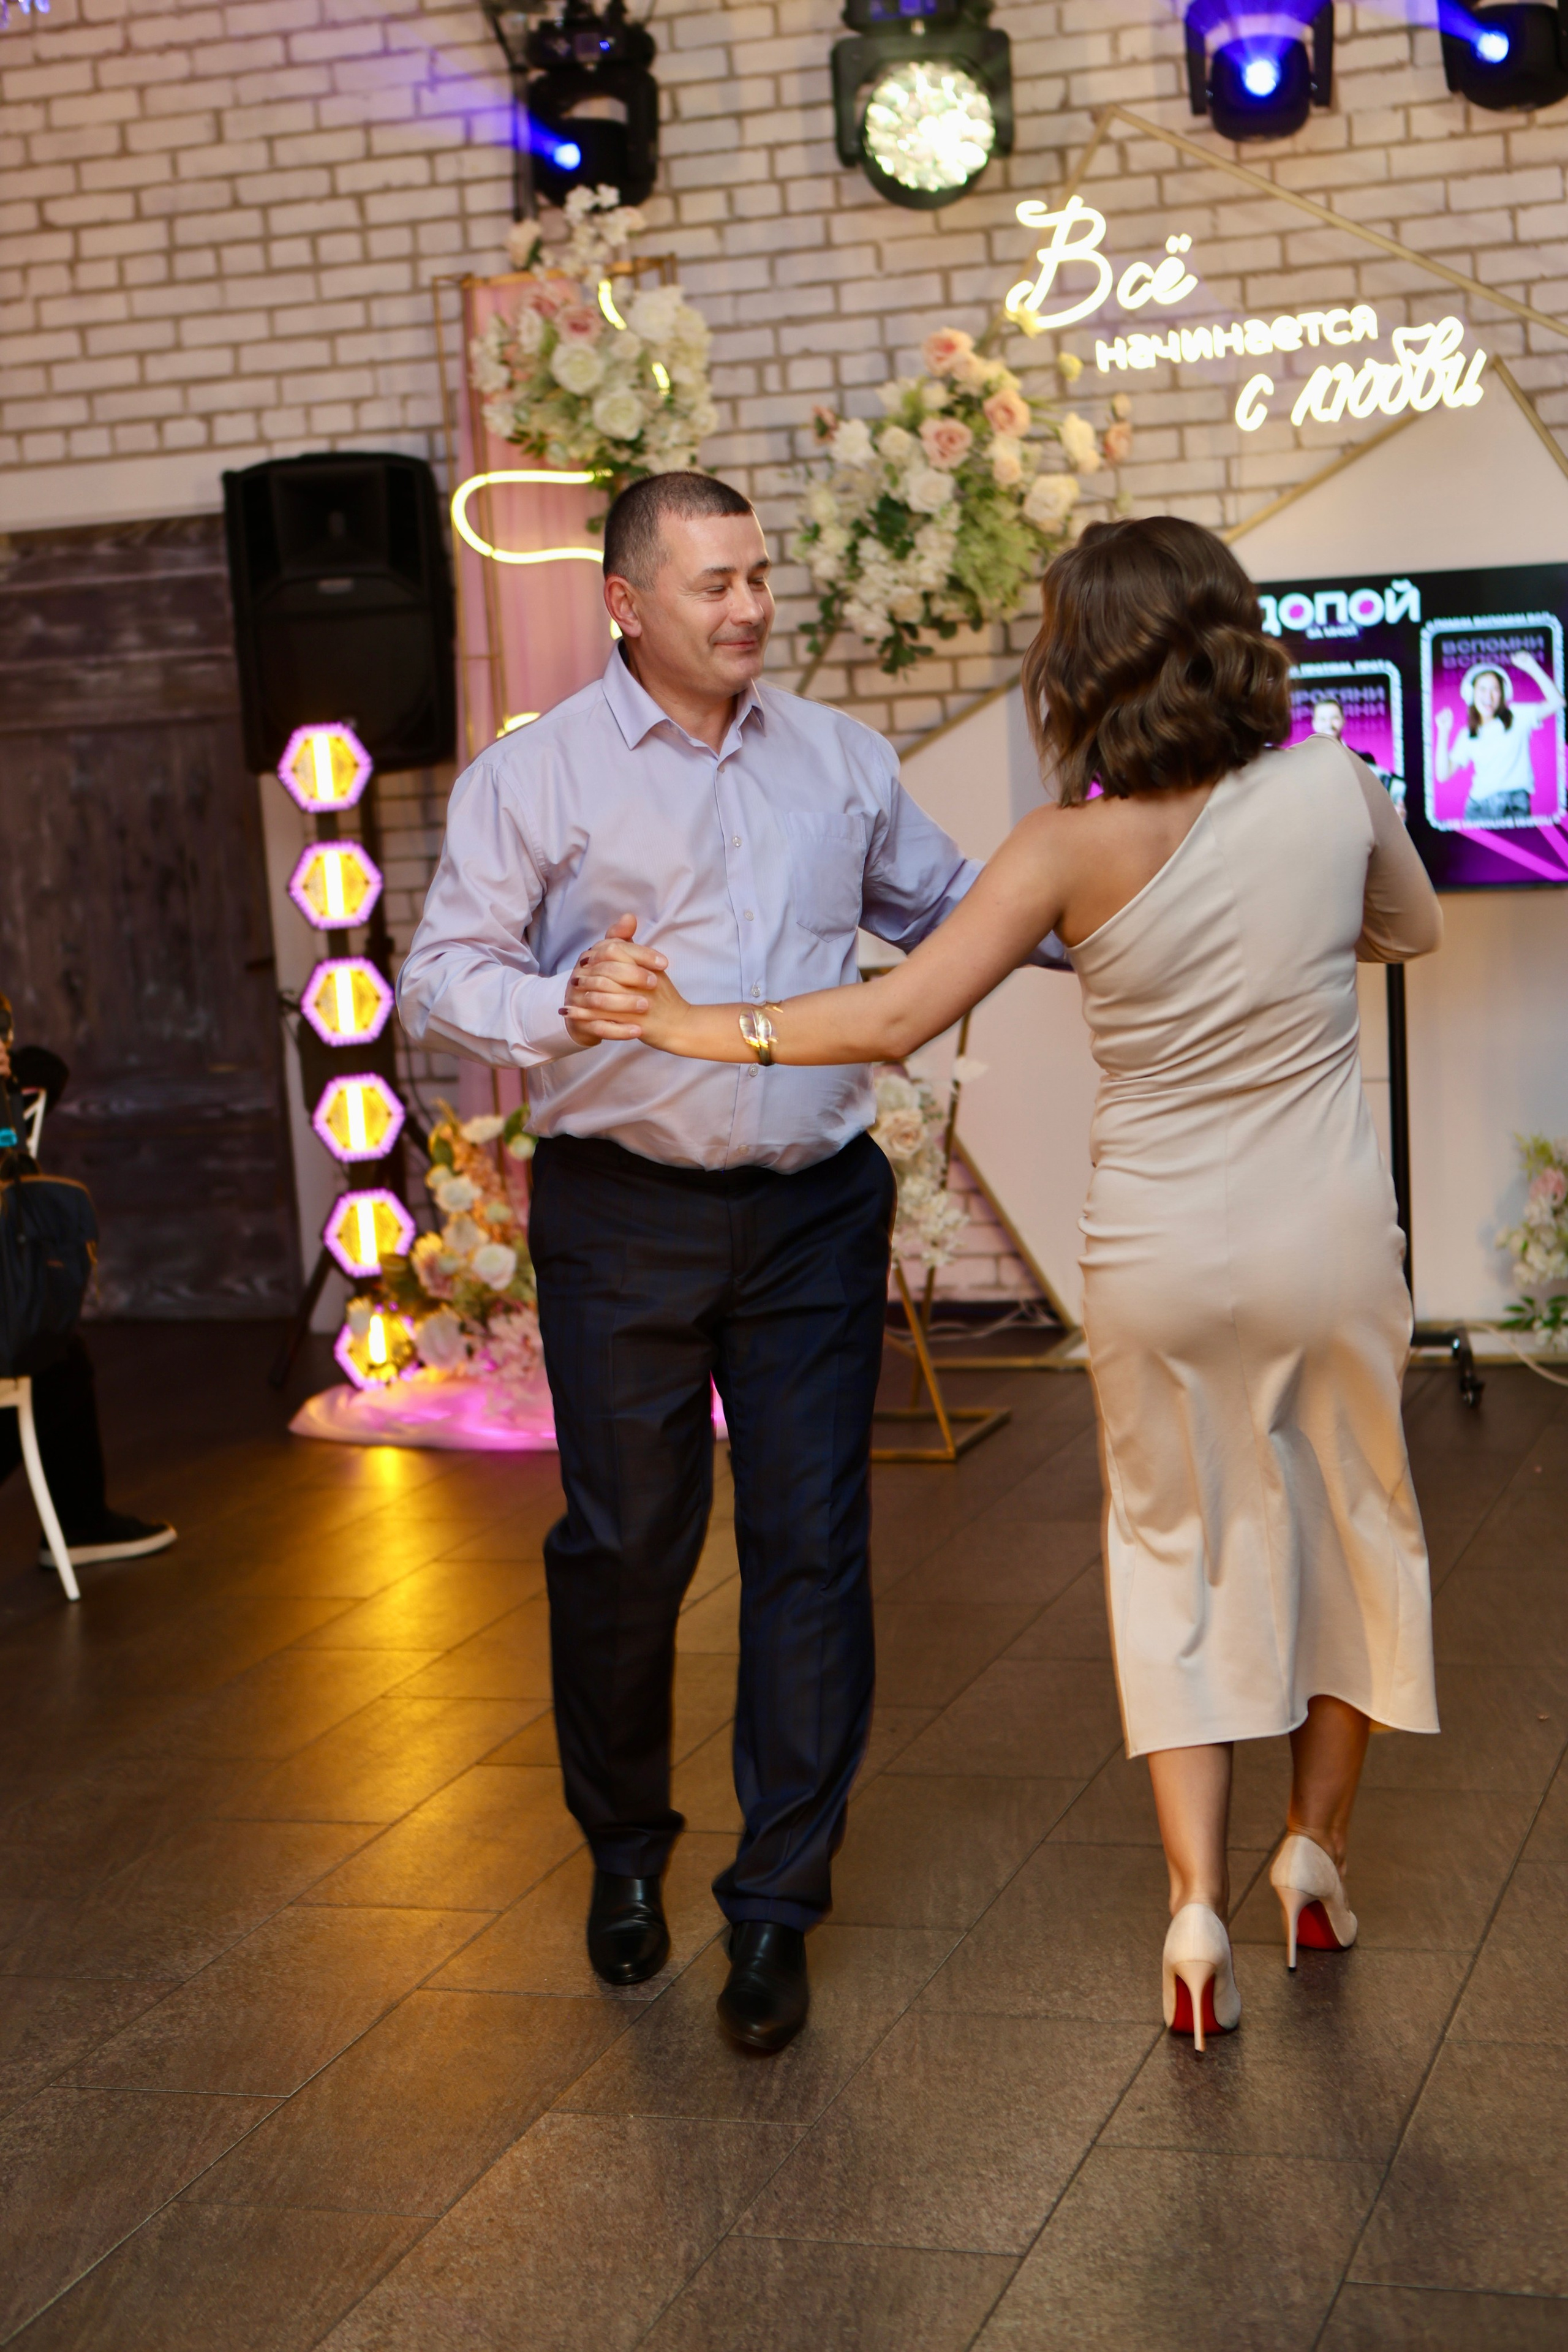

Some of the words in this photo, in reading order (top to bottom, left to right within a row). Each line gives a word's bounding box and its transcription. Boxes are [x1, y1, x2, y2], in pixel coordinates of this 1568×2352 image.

[1005, 195, 1198, 329] Всё
[1095, 304, 1379, 372] начинается
[1441, 635, 1545, 655] ВСПОМНИ
